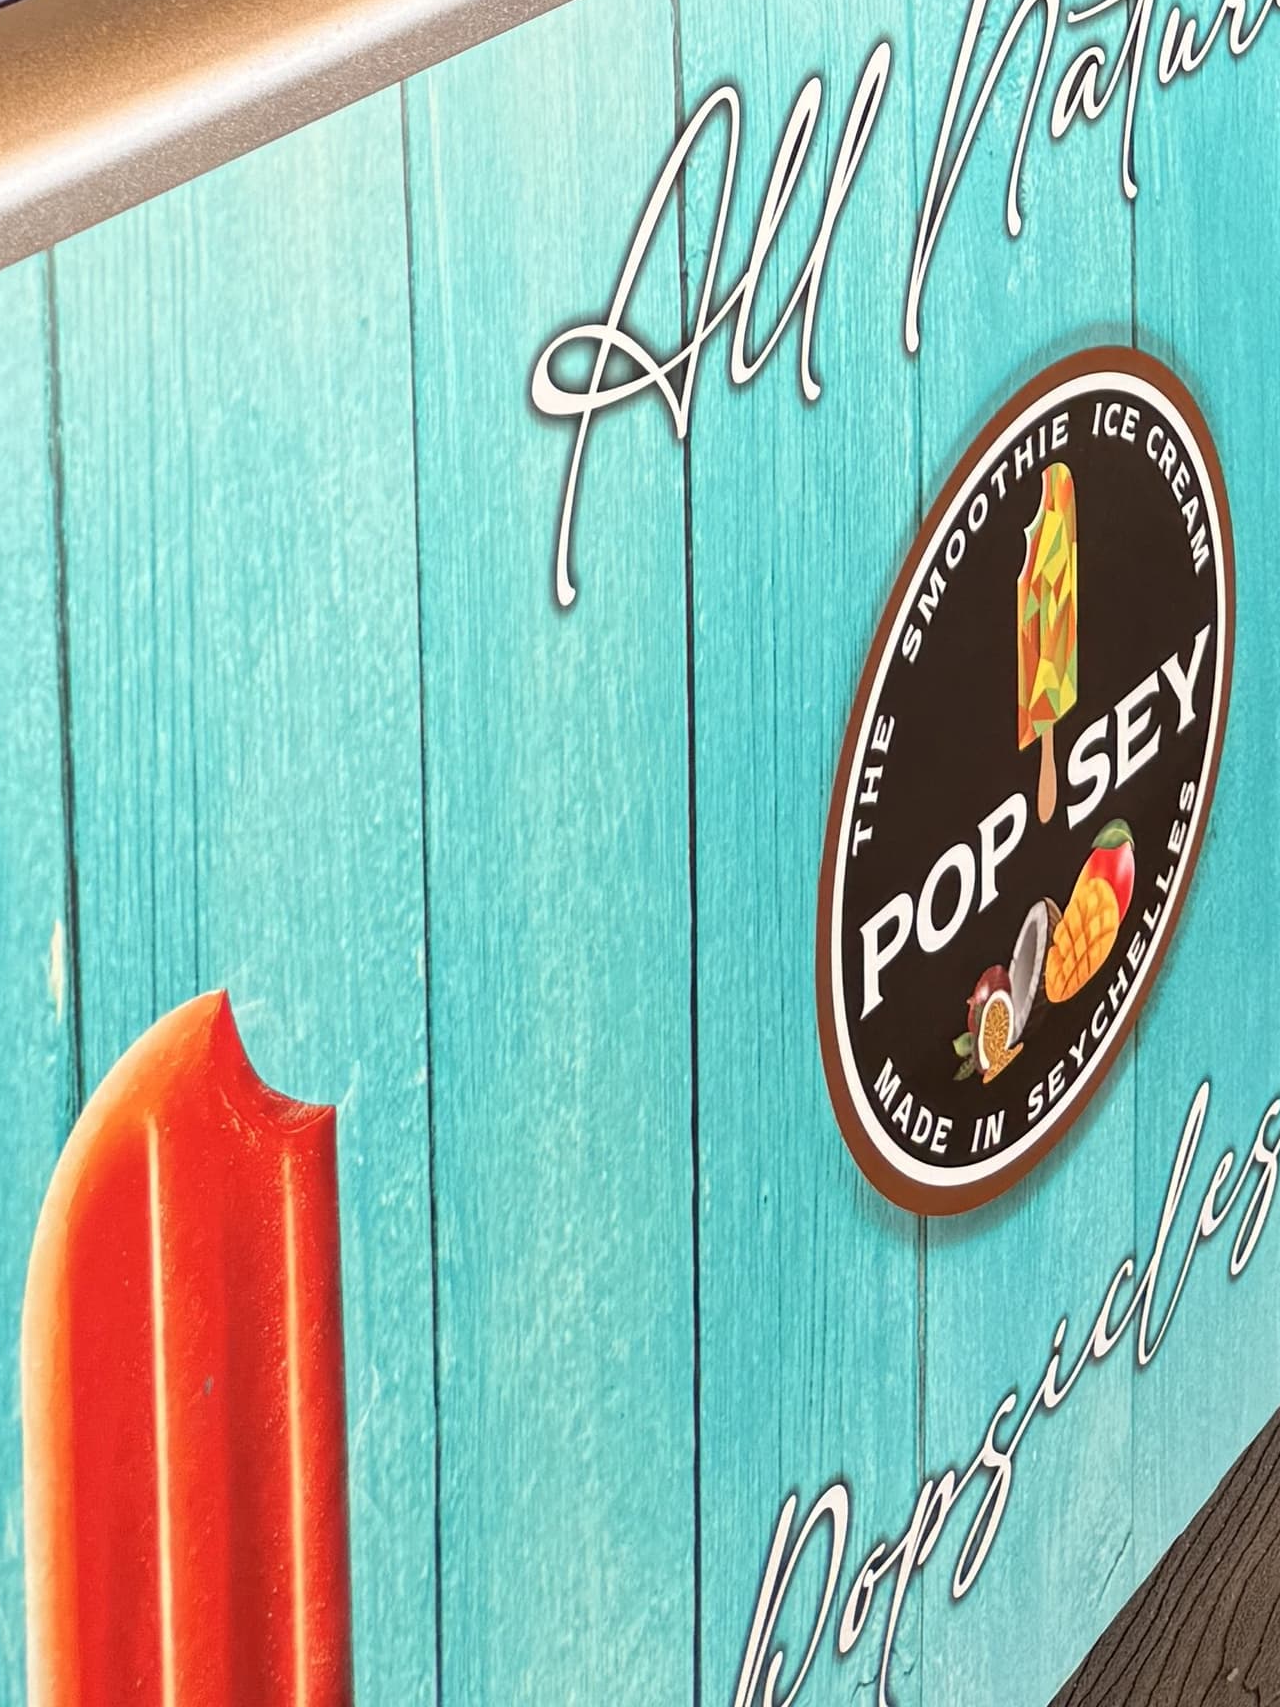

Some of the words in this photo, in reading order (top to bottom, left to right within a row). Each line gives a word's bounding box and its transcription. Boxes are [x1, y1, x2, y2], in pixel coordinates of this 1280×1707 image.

[530, 41, 890, 609] All
[850, 713, 896, 858] THE
[900, 410, 1072, 666] SMOOTHIE
[1091, 402, 1142, 444] ICE
[1145, 425, 1213, 577] CREAM
[859, 791, 1030, 1022] POP
[1064, 623, 1214, 832] SEY
[873, 1055, 955, 1156] MADE
[970, 1108, 1006, 1155] IN
[1025, 774, 1199, 1121] SEYCHELLES
